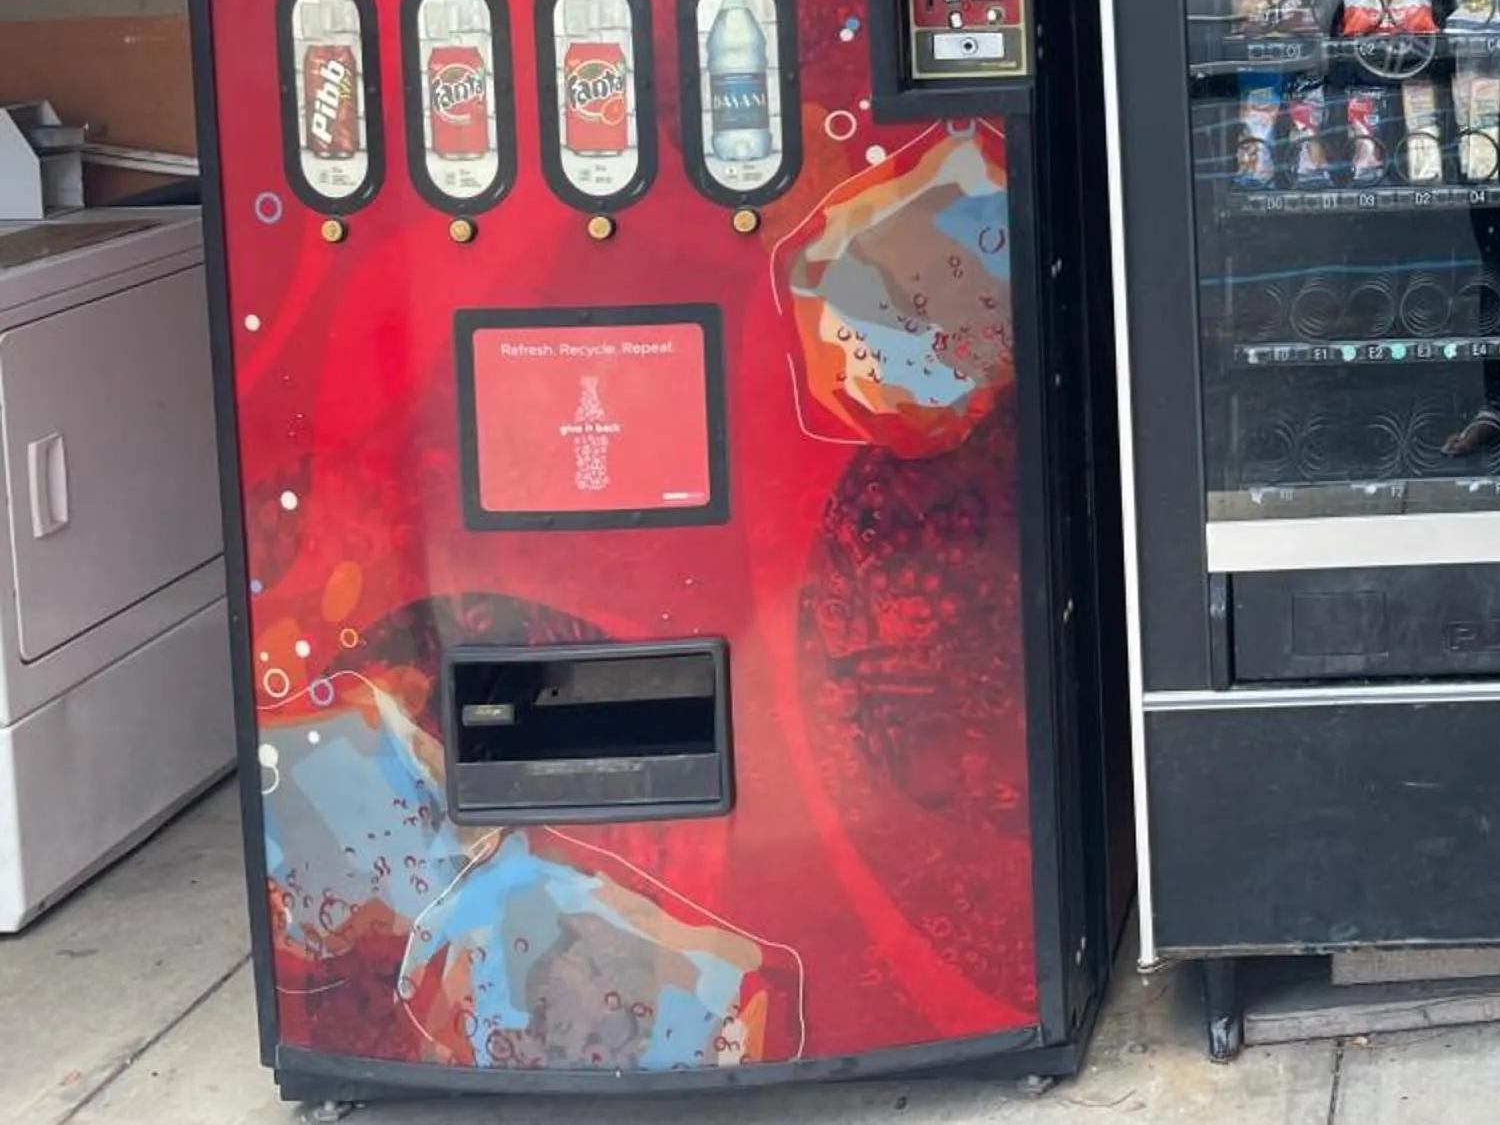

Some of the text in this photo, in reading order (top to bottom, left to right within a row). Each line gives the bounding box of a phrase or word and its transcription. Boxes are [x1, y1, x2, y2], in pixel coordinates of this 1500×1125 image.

[431, 71, 485, 112] Fanta
[567, 69, 625, 109] Fanta
[311, 60, 346, 145] Pibb
[1360, 194, 1375, 207] D3
[1415, 192, 1430, 205] D2
[1469, 190, 1486, 203] D4
[1314, 348, 1328, 360] E1
[1368, 346, 1383, 358] E2
[1417, 344, 1432, 357] E3
[1472, 343, 1487, 355] E4
